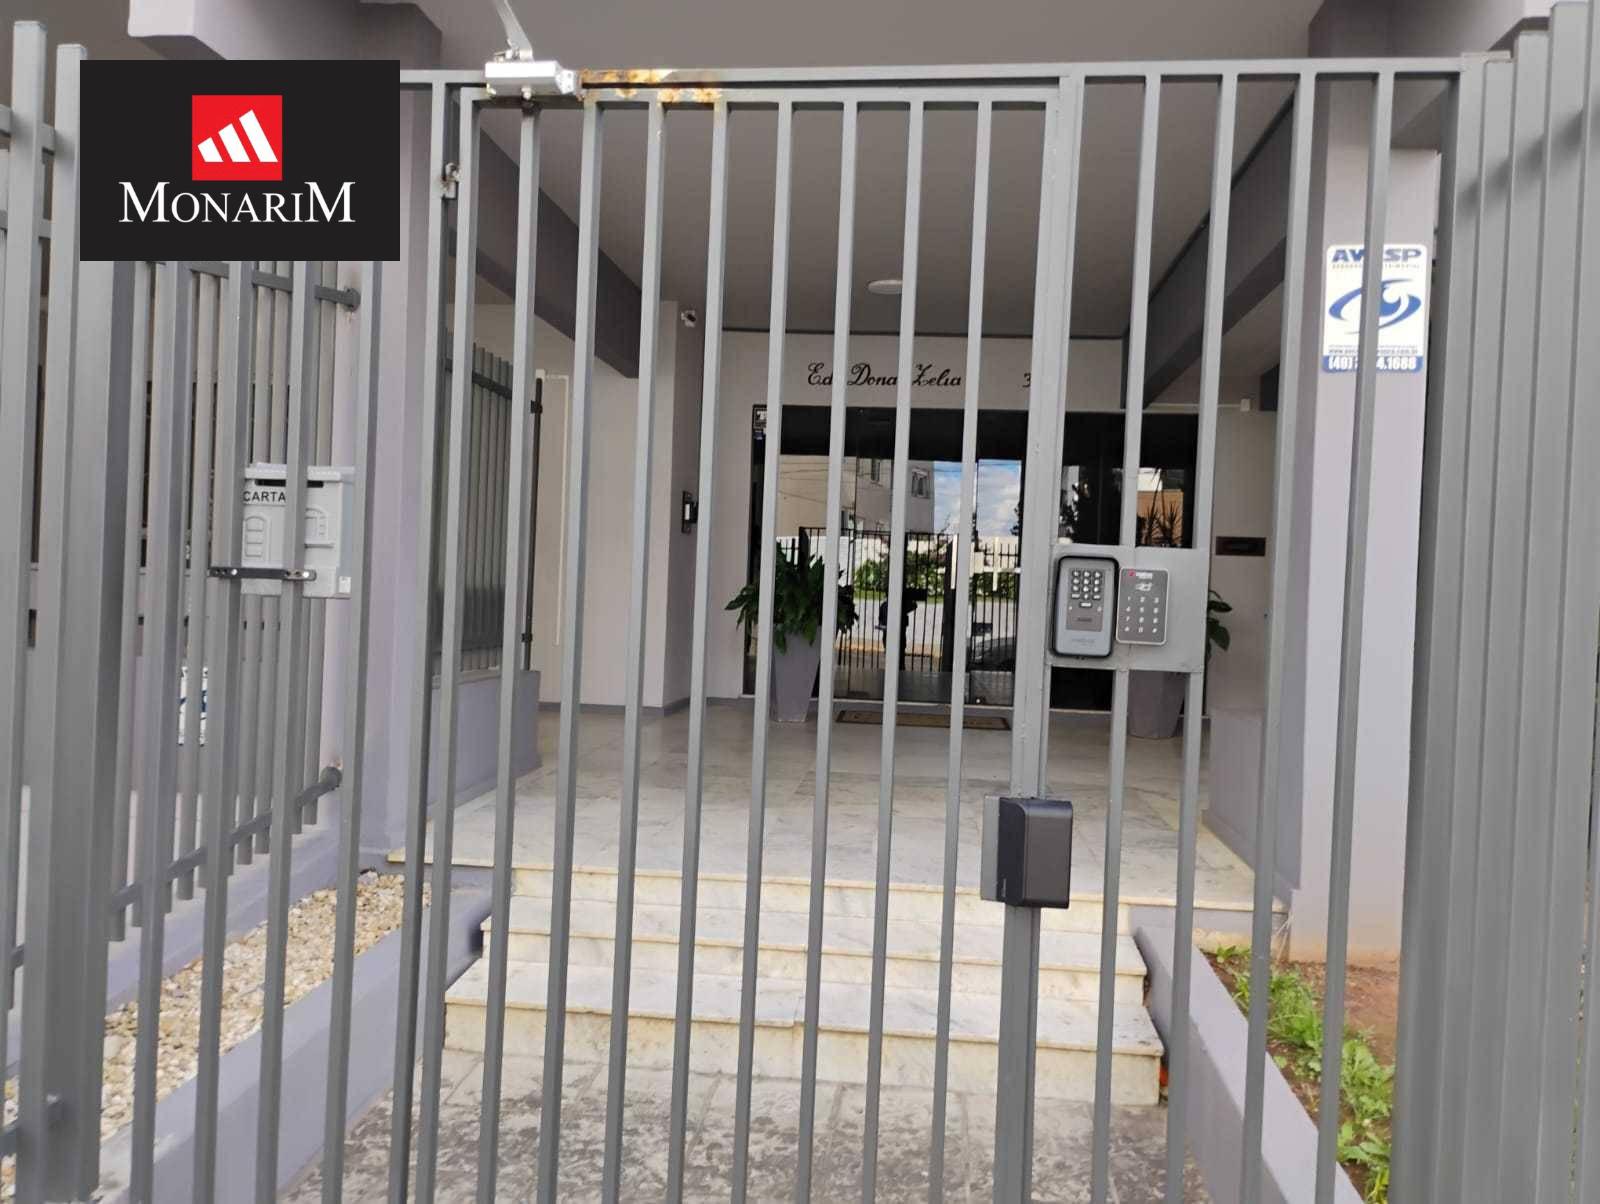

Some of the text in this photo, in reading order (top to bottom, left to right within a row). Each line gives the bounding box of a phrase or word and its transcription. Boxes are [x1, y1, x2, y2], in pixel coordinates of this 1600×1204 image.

[846, 361, 898, 386] Dona
[911, 363, 962, 386] Zelia
[242, 490, 287, 502] CARTA
